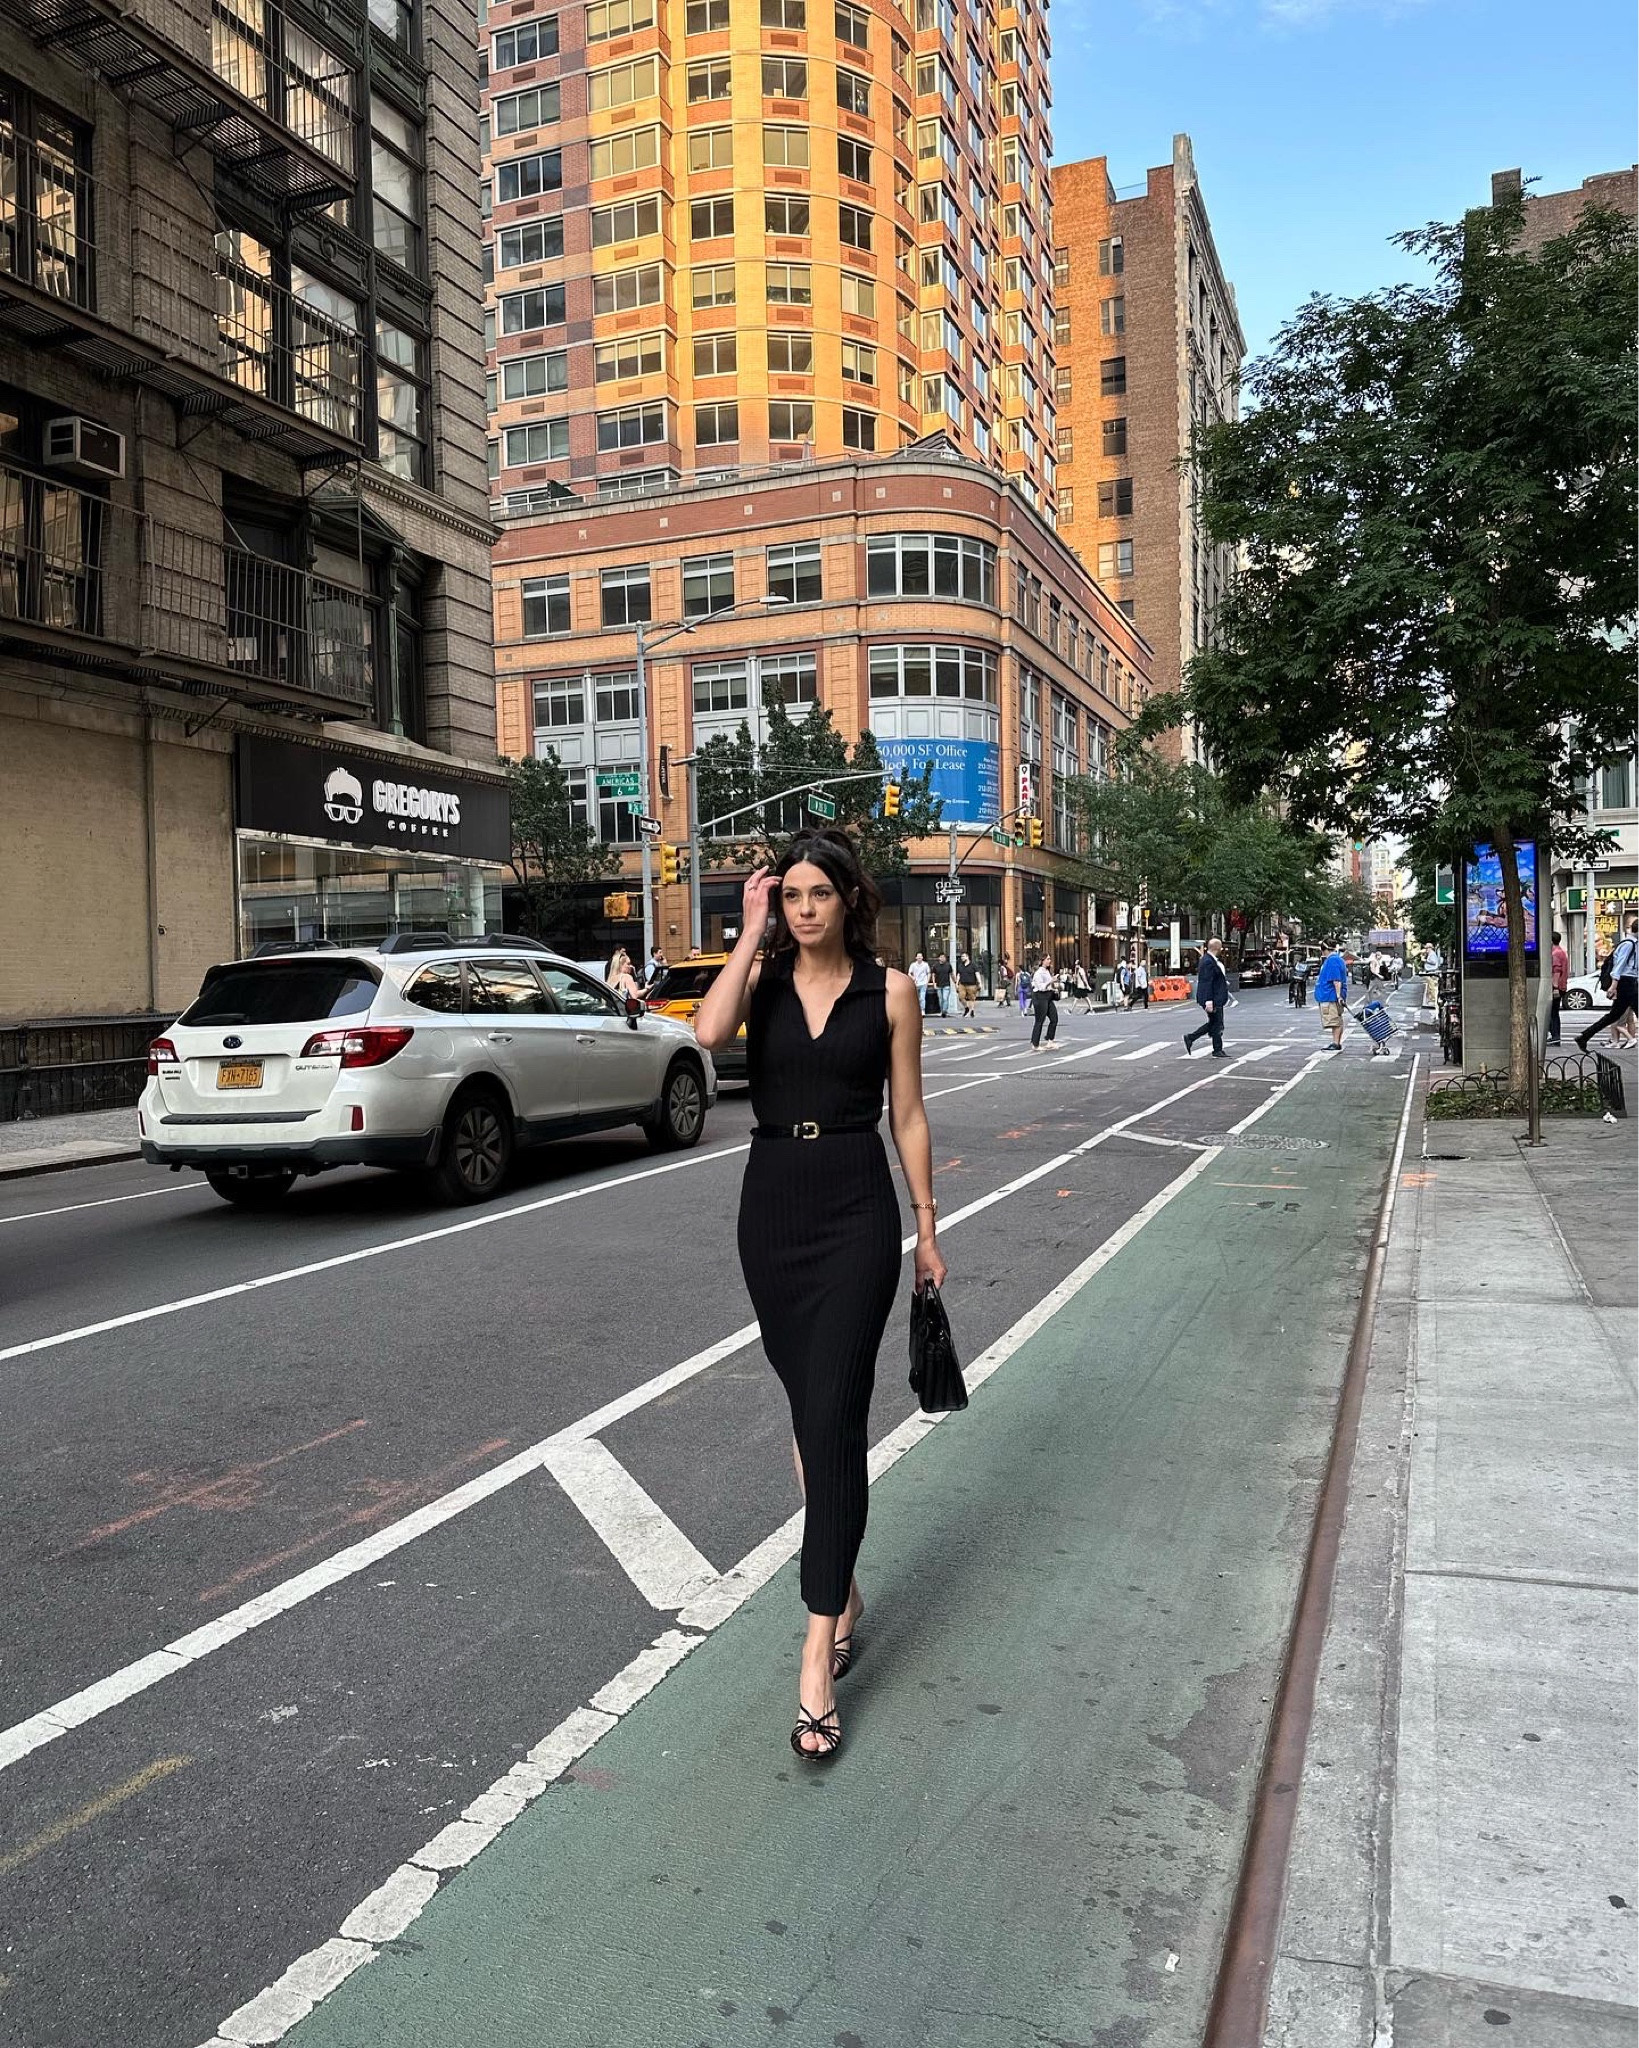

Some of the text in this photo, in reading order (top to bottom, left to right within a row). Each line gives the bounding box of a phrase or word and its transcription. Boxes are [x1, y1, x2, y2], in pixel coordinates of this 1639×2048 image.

[918, 745, 933, 757] SF
[936, 744, 968, 757] Office
[935, 759, 965, 771] Lease
[602, 776, 635, 786] AMERICAS
[617, 786, 623, 796] 6
[372, 779, 461, 825] GREGORYS
[387, 819, 449, 837] COFFEE
